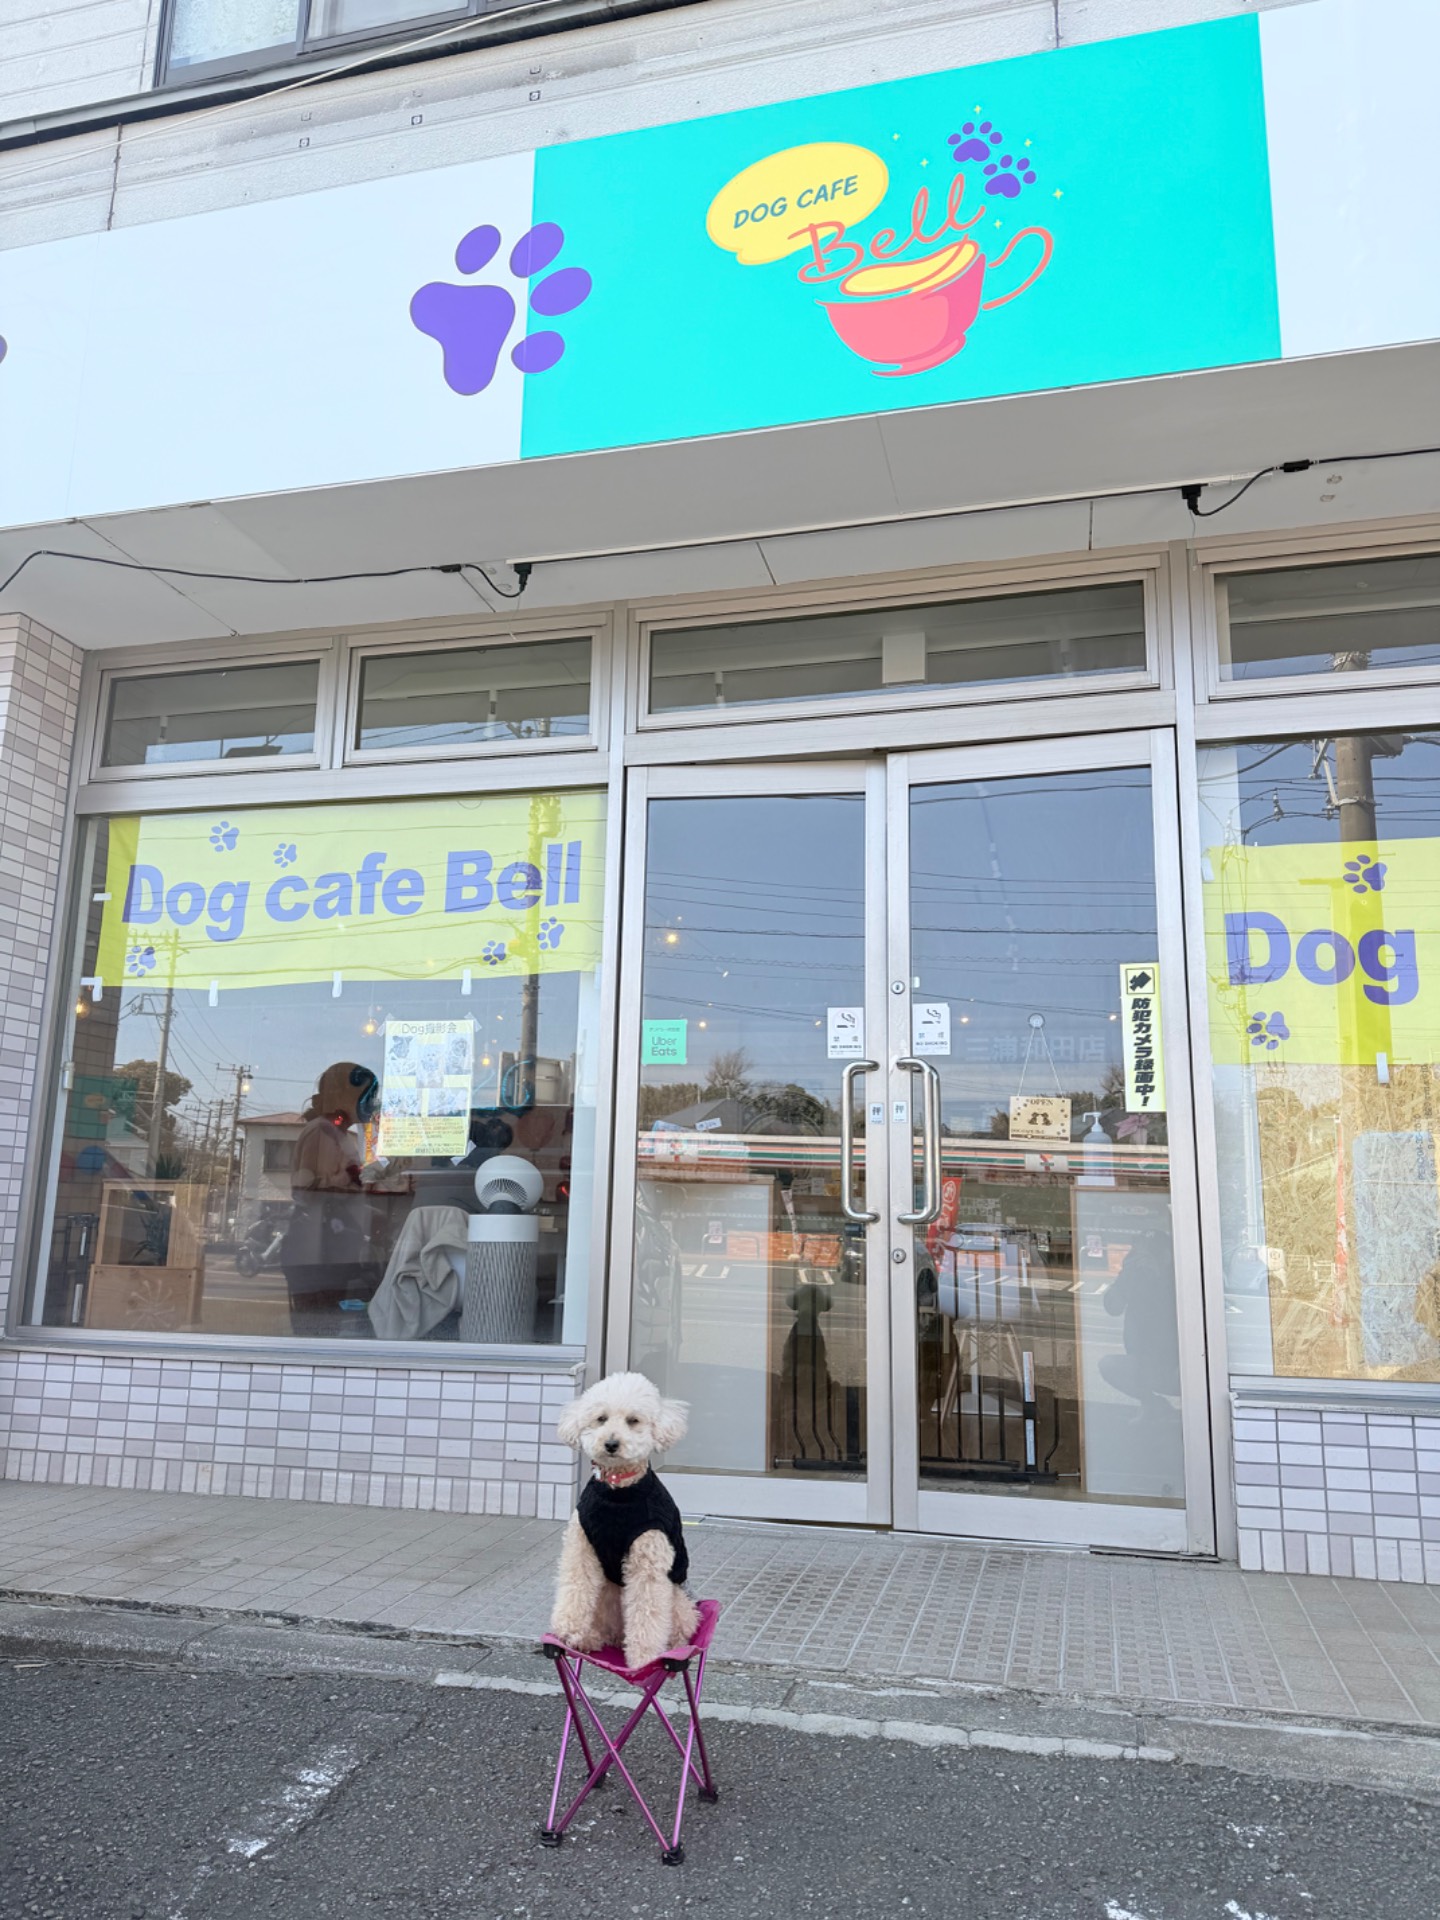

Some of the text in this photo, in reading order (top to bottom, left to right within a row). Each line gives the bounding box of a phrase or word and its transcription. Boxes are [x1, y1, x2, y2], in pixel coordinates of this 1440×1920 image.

[733, 174, 859, 229] DOG CAFE
[787, 172, 986, 284] Bell
[121, 839, 583, 943] Dog cafe Bell
[1224, 911, 1420, 1006] Dog
[651, 1036, 678, 1046] Uber
[651, 1046, 678, 1057] Eats
